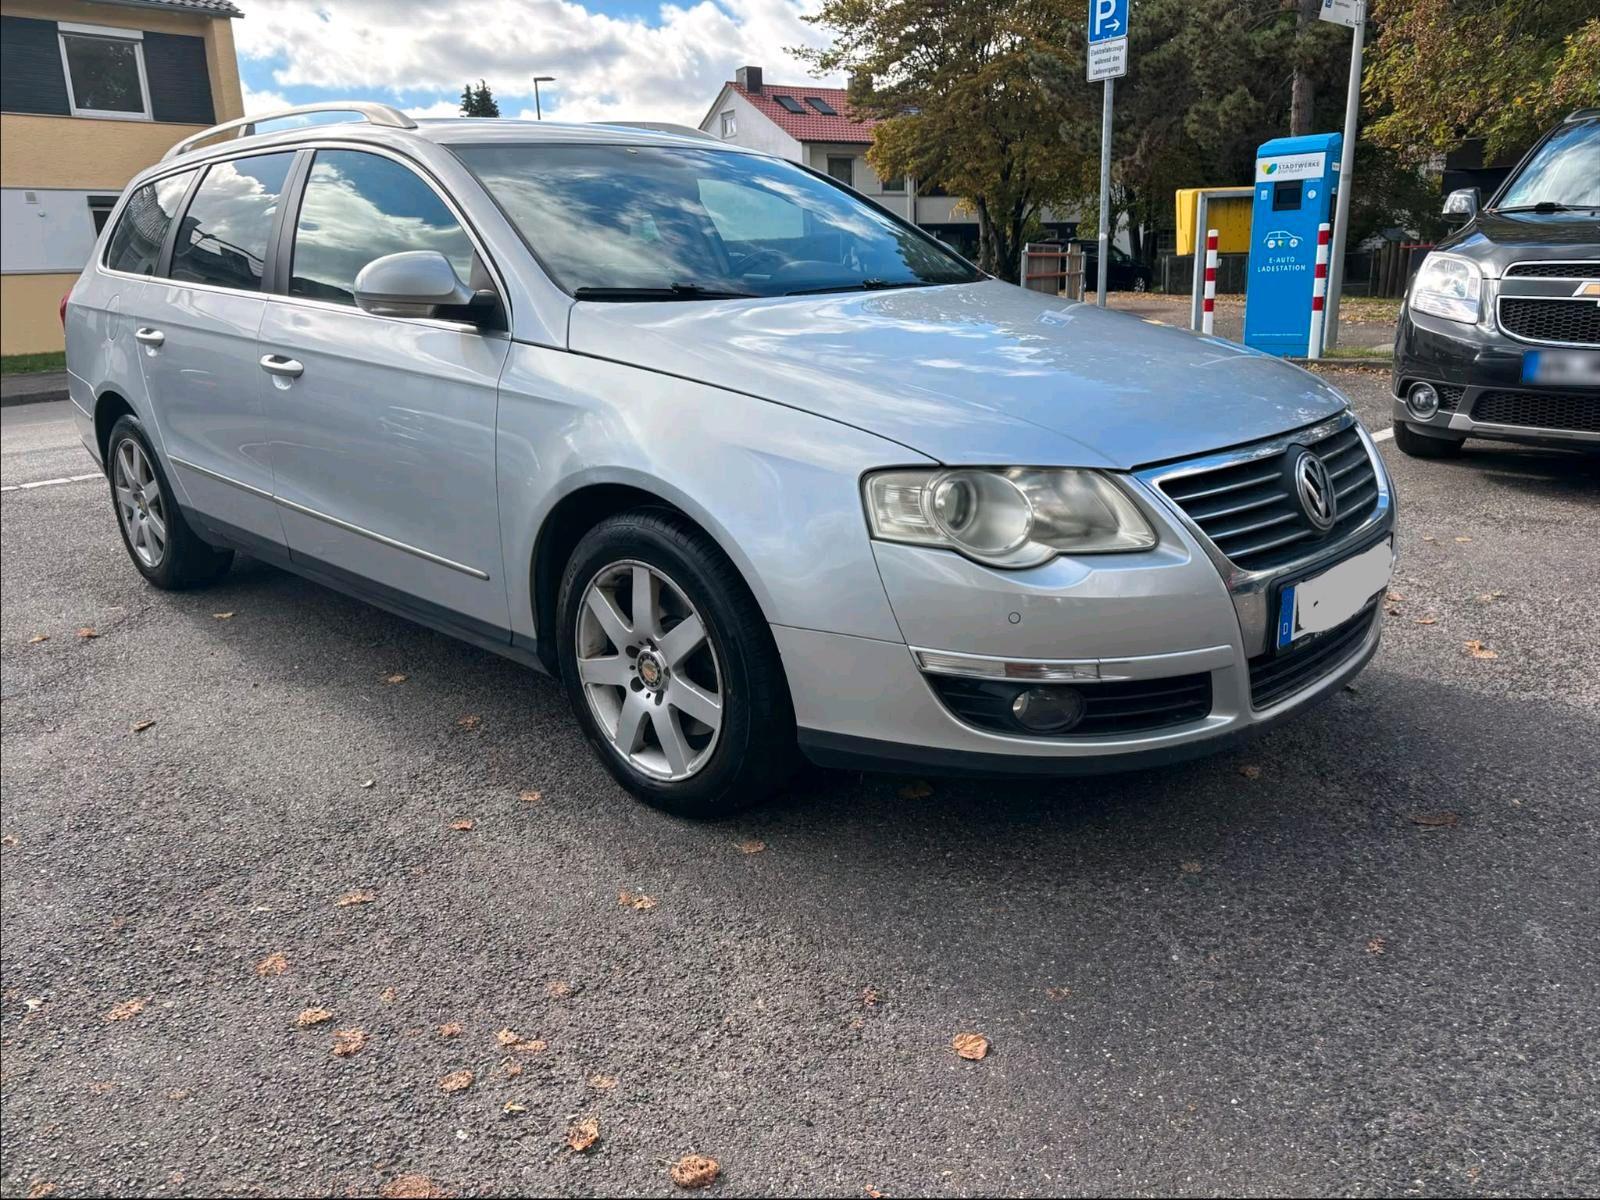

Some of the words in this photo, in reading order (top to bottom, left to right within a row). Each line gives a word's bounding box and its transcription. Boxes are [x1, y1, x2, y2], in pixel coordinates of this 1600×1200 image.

[1095, 0, 1116, 35] P
[1279, 161, 1320, 169] STADTWERKE
[1283, 622, 1288, 635] D
